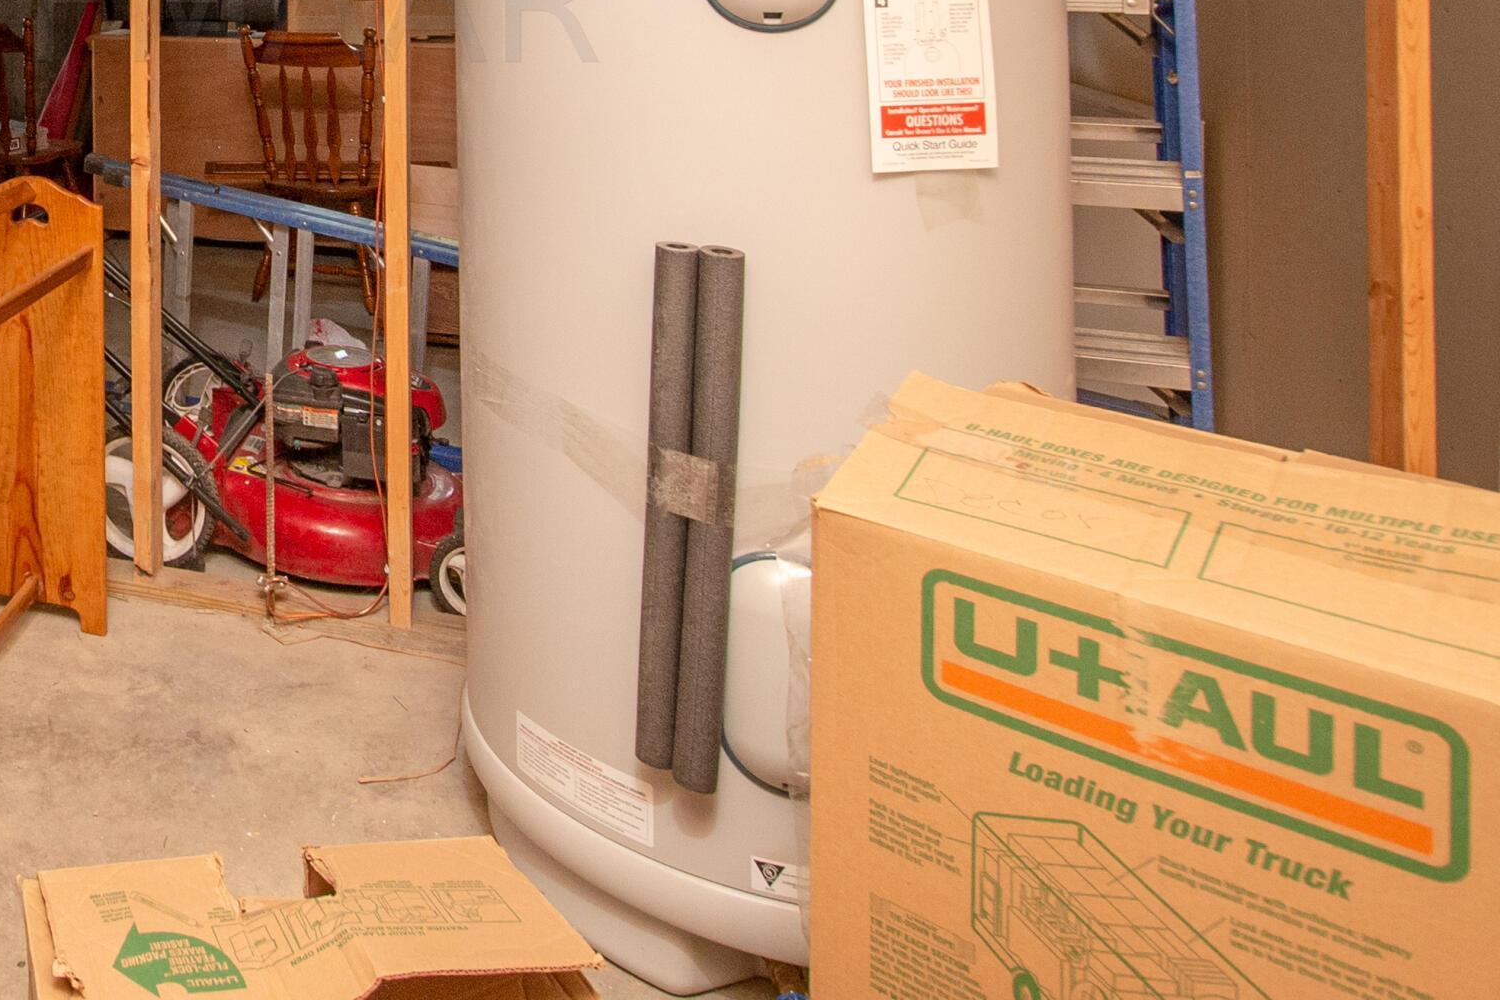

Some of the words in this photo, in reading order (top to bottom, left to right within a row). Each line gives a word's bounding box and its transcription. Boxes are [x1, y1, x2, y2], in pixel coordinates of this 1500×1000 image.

[884, 79, 902, 88] YOUR
[892, 89, 920, 98] SHOULD
[921, 88, 939, 98] LOOK
[905, 114, 964, 128] QUESTIONS
[892, 140, 920, 152] Quick
[922, 139, 946, 150] Start
[948, 138, 979, 149] Guide
[1040, 440, 1105, 463] BOXES
[1108, 457, 1154, 474] ARE
[1157, 469, 1268, 502] DESIGNED
[1273, 495, 1321, 514] FOR
[1325, 505, 1445, 536] MULTIPLE
[1116, 473, 1180, 496] Moves
[1216, 498, 1299, 525] Storage
[1392, 534, 1459, 555] Years
[1007, 750, 1138, 825] Loading
[1151, 803, 1234, 854] Your
[1245, 838, 1354, 901] Truck
[120, 949, 168, 969] PACKING
[290, 949, 315, 968] OPEN
[187, 975, 240, 988] U-HAUL
